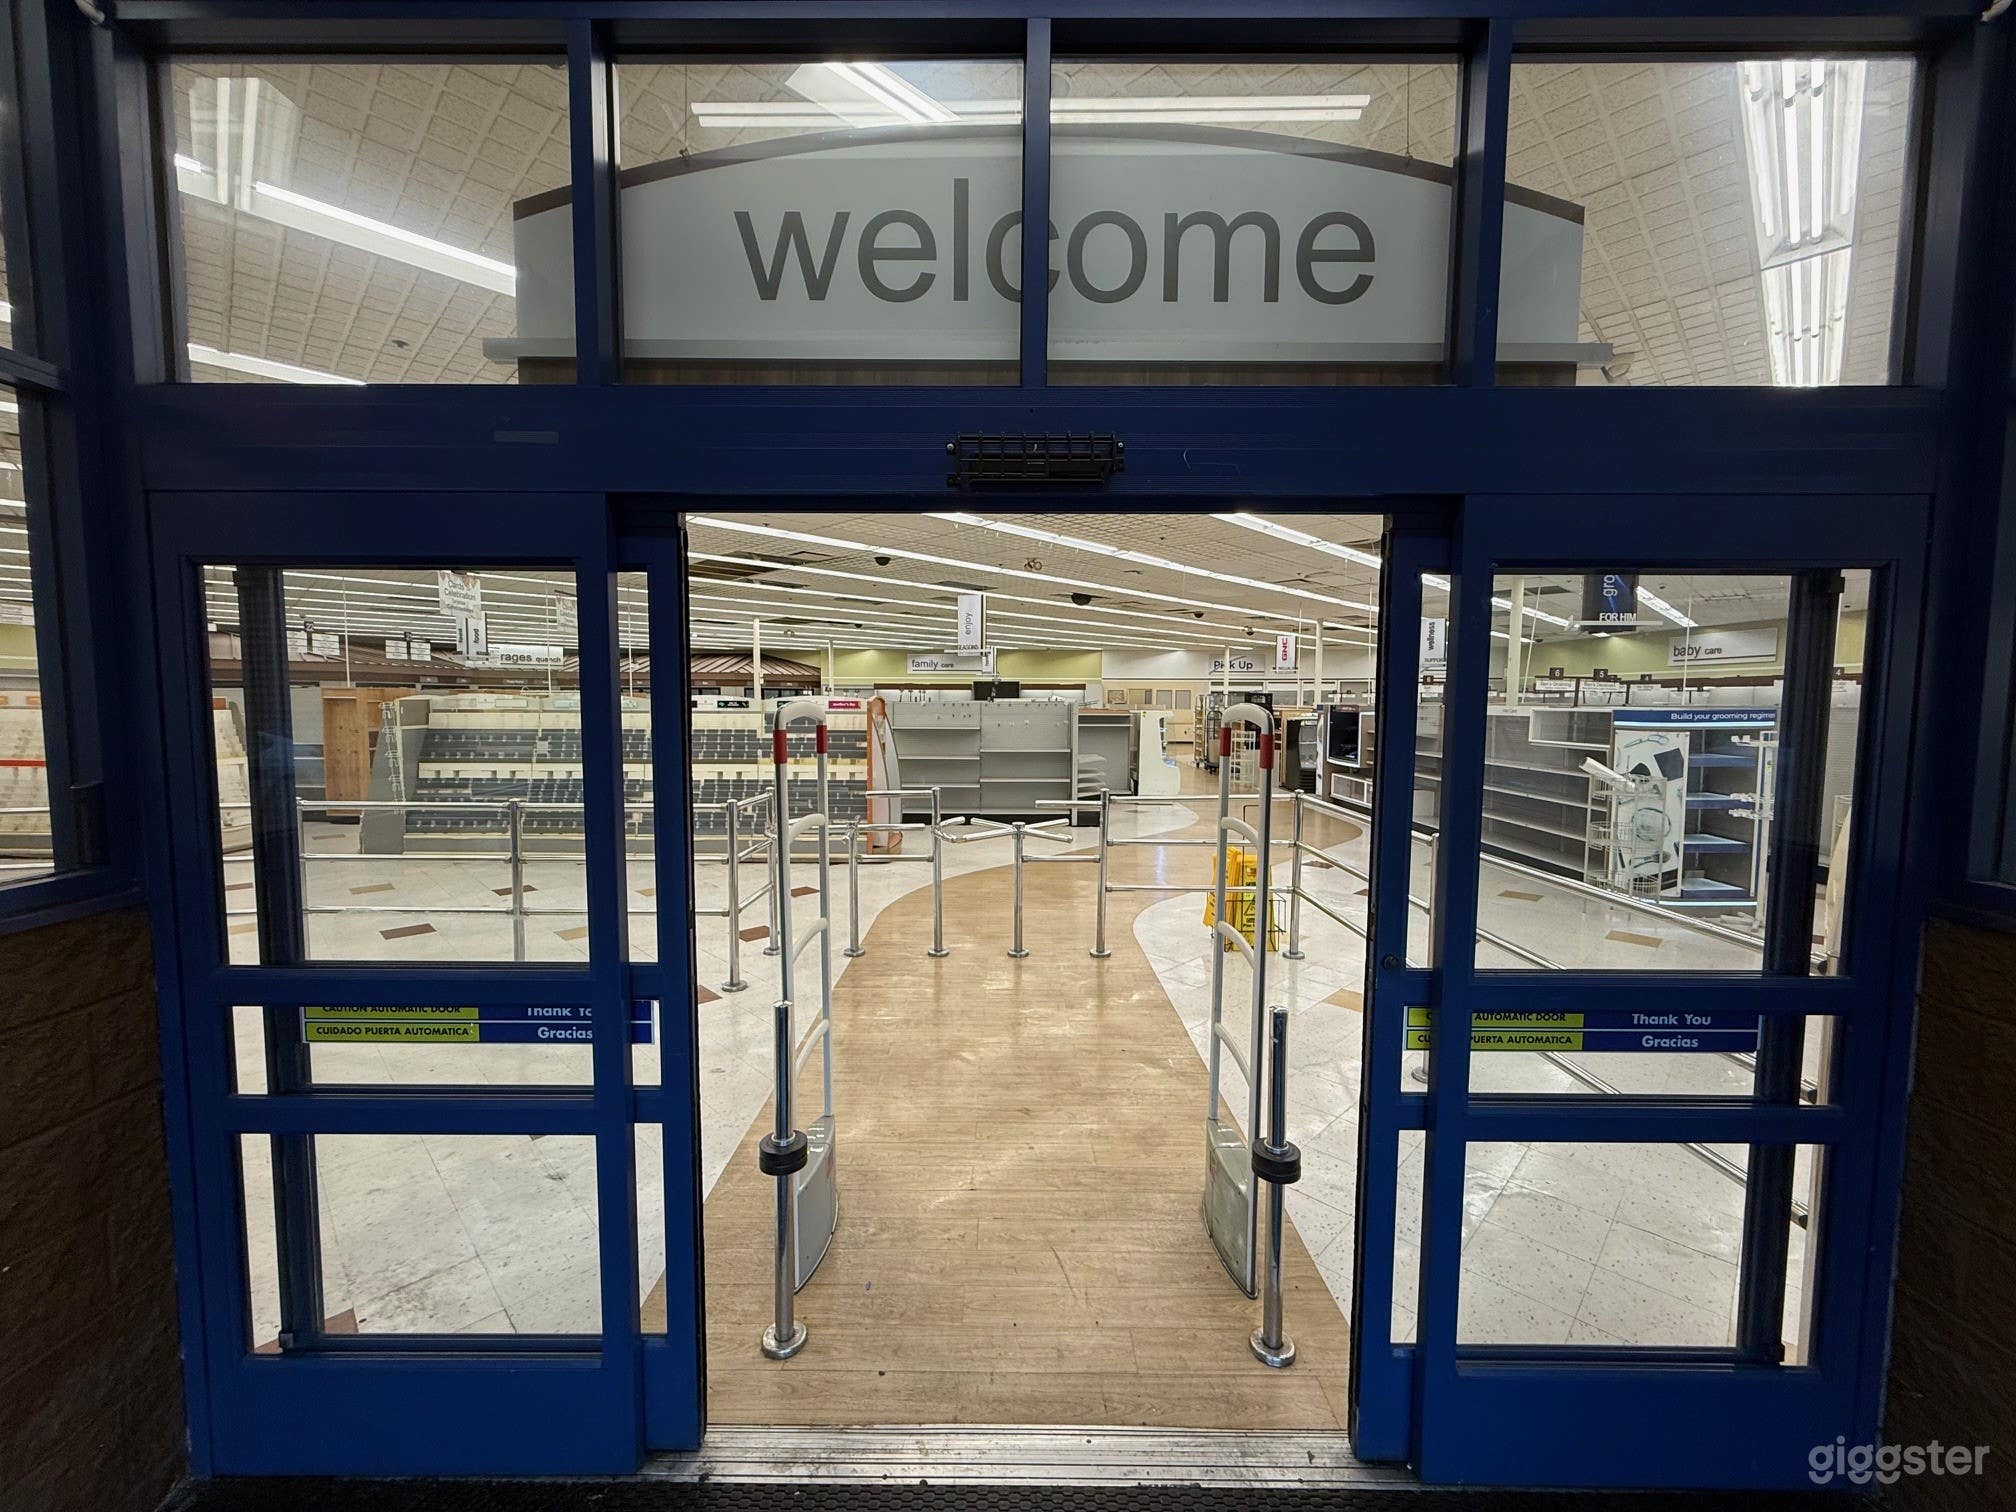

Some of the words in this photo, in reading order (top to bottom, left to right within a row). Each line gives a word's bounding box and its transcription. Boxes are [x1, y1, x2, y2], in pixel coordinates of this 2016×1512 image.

[733, 178, 1376, 304] welcome
[1599, 612, 1618, 622] FOR
[1619, 612, 1637, 622] HIM
[964, 612, 974, 635] enjoy
[1427, 621, 1436, 651] wellness
[1673, 644, 1701, 658] baby
[1704, 647, 1722, 655] care
[911, 659, 939, 671] family
[1213, 660, 1235, 670] Pik
[1238, 660, 1254, 671] Up
[1554, 669, 1561, 677] 6
[1599, 670, 1605, 678] 5
[1670, 712, 1693, 720] Build
[1694, 713, 1711, 721] your
[1711, 712, 1748, 721] grooming
[1474, 1012, 1533, 1021] AUTOMATIC
[1535, 1013, 1566, 1022] DOOR
[1631, 1013, 1679, 1025] Thank
[1684, 1013, 1712, 1026] You
[316, 1026, 362, 1035] CUIDADO
[364, 1027, 401, 1036] PUERTA
[404, 1027, 470, 1036] AUTOMATICA
[537, 1026, 593, 1039] Gracias
[1507, 1035, 1573, 1044] AUTOMATICA
[1641, 1034, 1699, 1048] Gracias
